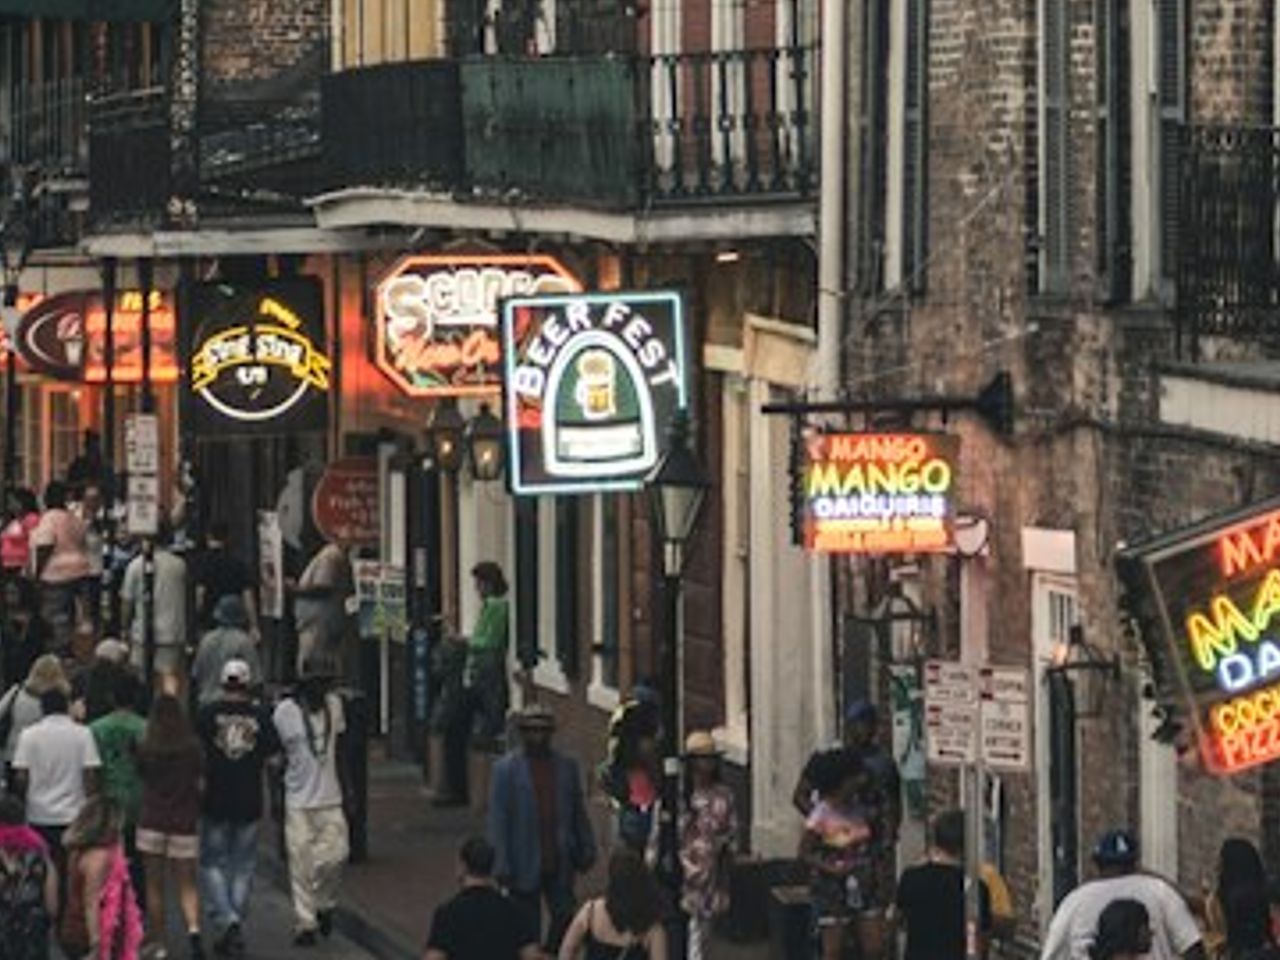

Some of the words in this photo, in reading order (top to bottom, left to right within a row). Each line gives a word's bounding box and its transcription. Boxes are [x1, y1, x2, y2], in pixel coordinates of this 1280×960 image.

[512, 298, 592, 397] BEER
[603, 301, 683, 390] FEST
[830, 436, 926, 461] MANGO
[809, 458, 952, 496] MANGO
